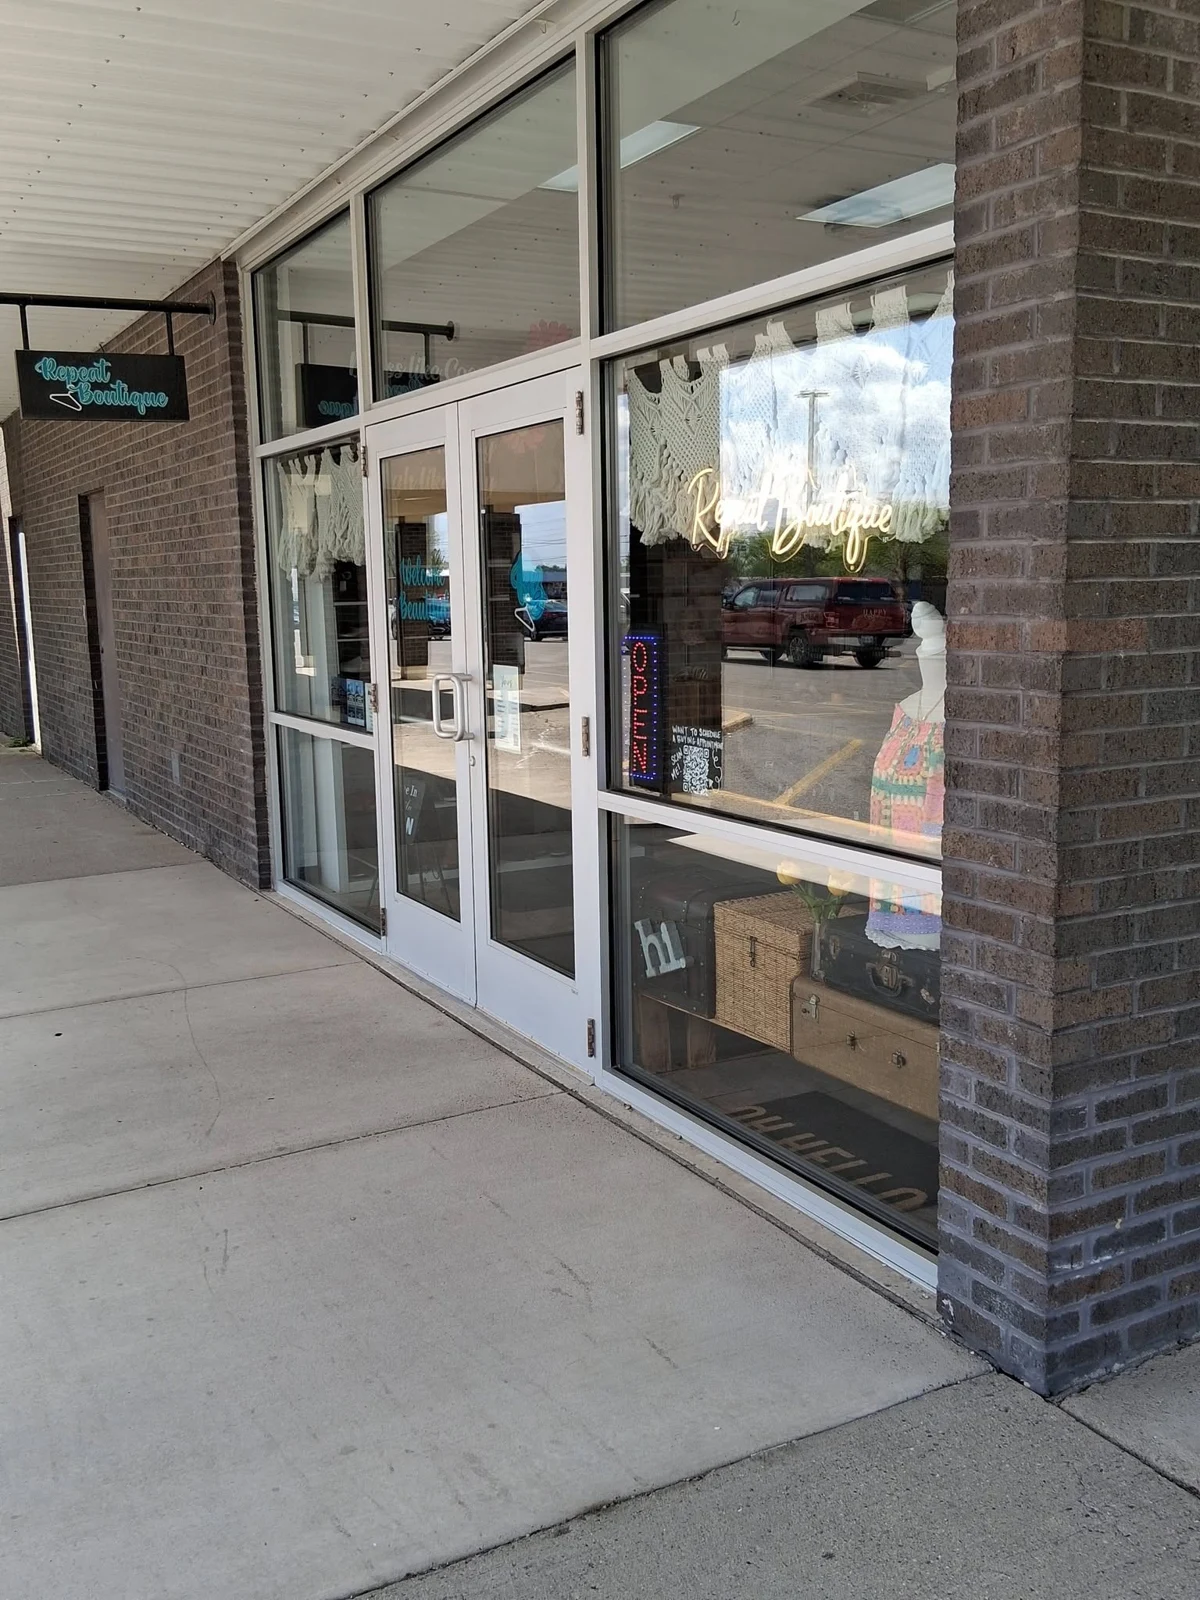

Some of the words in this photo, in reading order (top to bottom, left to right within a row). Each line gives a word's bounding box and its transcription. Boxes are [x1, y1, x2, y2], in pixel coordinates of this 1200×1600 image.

[34, 356, 112, 387] Repeat
[67, 379, 169, 416] Boutique
[632, 641, 648, 774] OPEN
[672, 725, 688, 737] WANT
[690, 727, 698, 737] TO
[699, 728, 722, 739] SCHEDULE
[671, 747, 683, 766] SCAN
